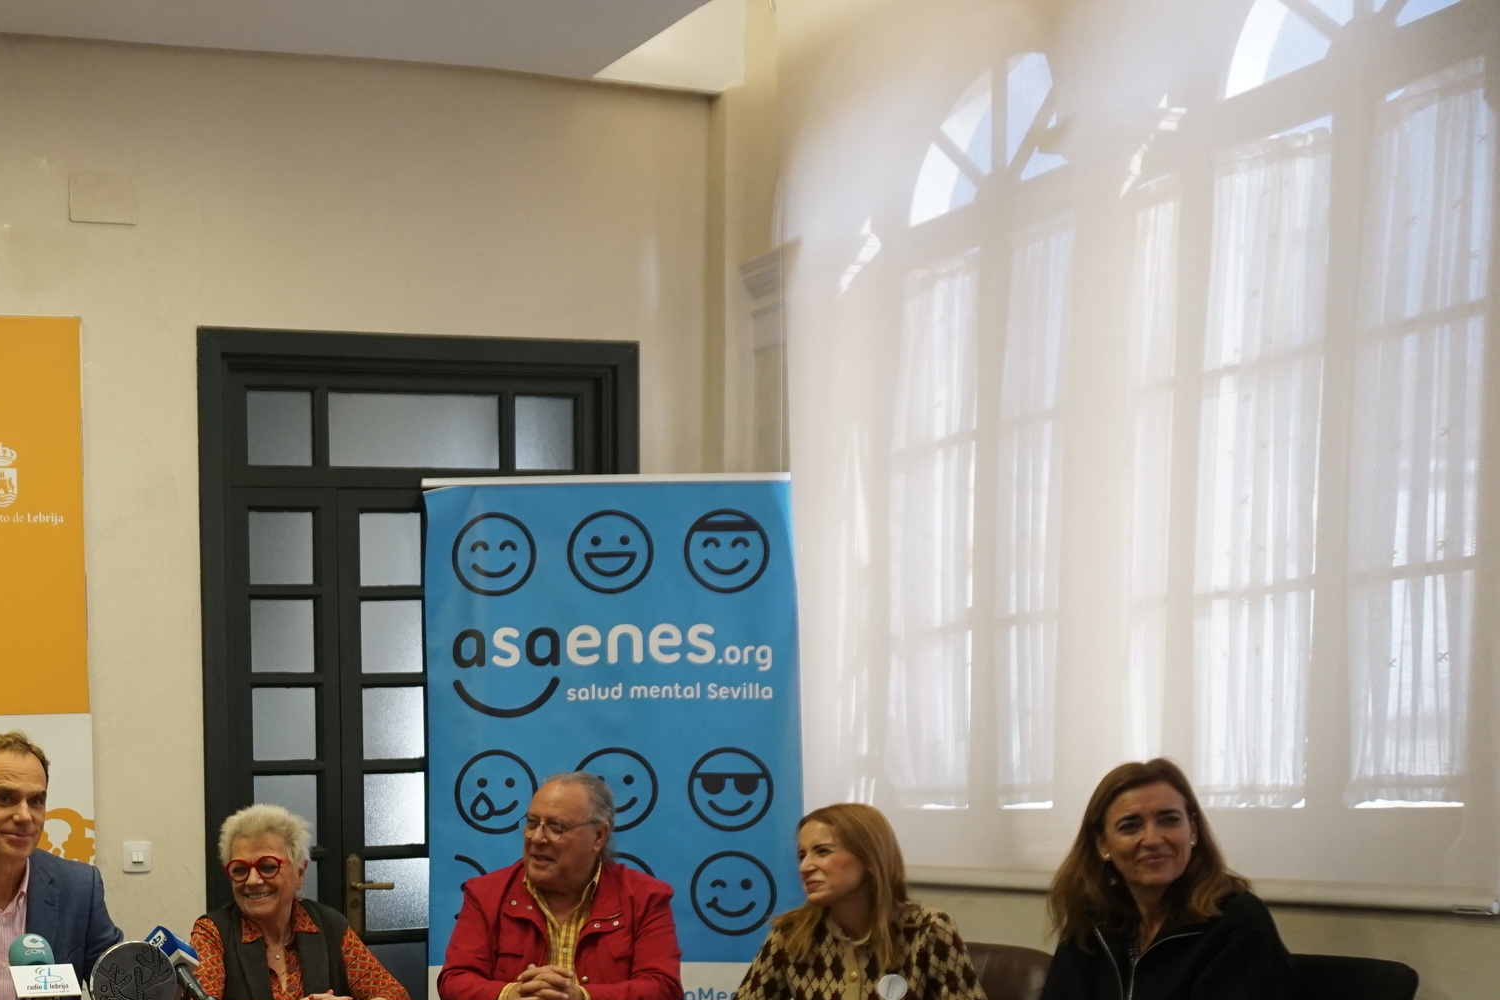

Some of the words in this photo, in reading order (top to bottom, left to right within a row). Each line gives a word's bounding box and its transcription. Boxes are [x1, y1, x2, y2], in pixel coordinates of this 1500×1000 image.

[12, 512, 24, 523] de
[27, 512, 64, 526] Lebrija
[452, 623, 773, 671] asaenes.org
[567, 683, 622, 701] salud
[630, 682, 700, 699] mental
[707, 682, 773, 700] Sevilla
